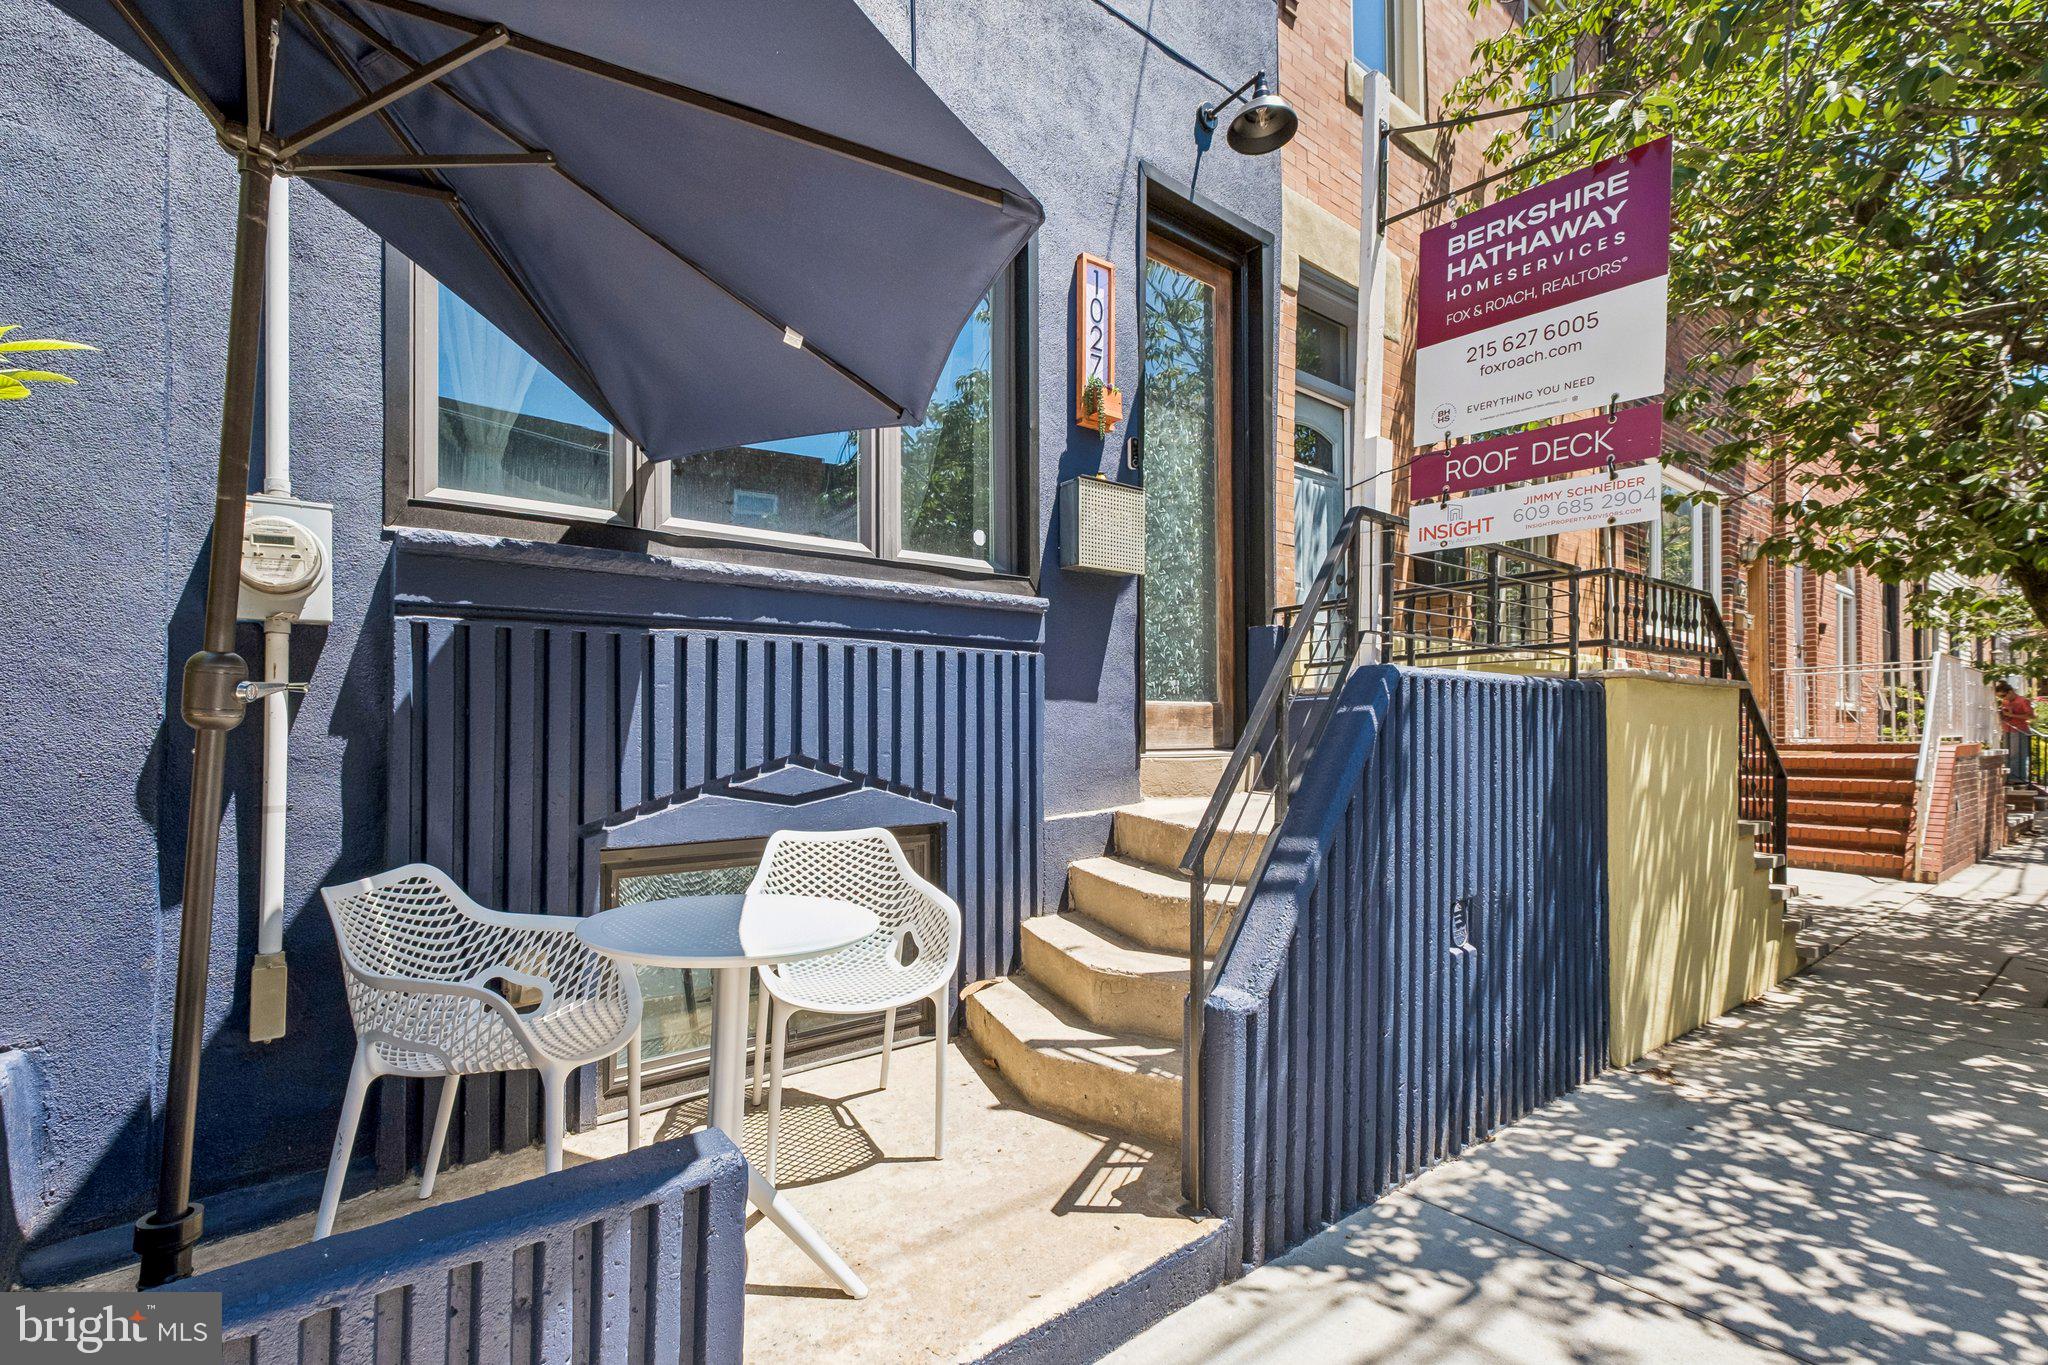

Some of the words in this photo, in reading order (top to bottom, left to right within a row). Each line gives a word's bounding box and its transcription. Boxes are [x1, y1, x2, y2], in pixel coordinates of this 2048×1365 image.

[1447, 170, 1630, 256] BERKSHIRE
[1446, 199, 1628, 281] HATHAWAY
[1446, 231, 1627, 302] HOMESERVICES
[1090, 269, 1103, 376] 1027
[1446, 309, 1471, 326] FOX
[1473, 305, 1483, 318] &
[1485, 286, 1539, 312] ROACH,
[1466, 341, 1498, 364] 215
[1502, 329, 1539, 353] 627
[1543, 311, 1600, 340] 6005
[1479, 340, 1583, 377] foxroach.com
[1437, 408, 1451, 418] BH
[1466, 390, 1533, 414] EVERYTHING
[1536, 383, 1560, 397] YOU
[1564, 375, 1595, 390] NEED
[1437, 415, 1450, 424] HS
[1445, 446, 1519, 482] ROOF
[1532, 426, 1615, 466] DECK
[1513, 504, 1550, 523] 609
[1557, 497, 1593, 516] 685
[1601, 486, 1657, 510] 2904
[1523, 490, 1563, 506] JIMMY
[1567, 476, 1645, 499] SCHNEIDER
